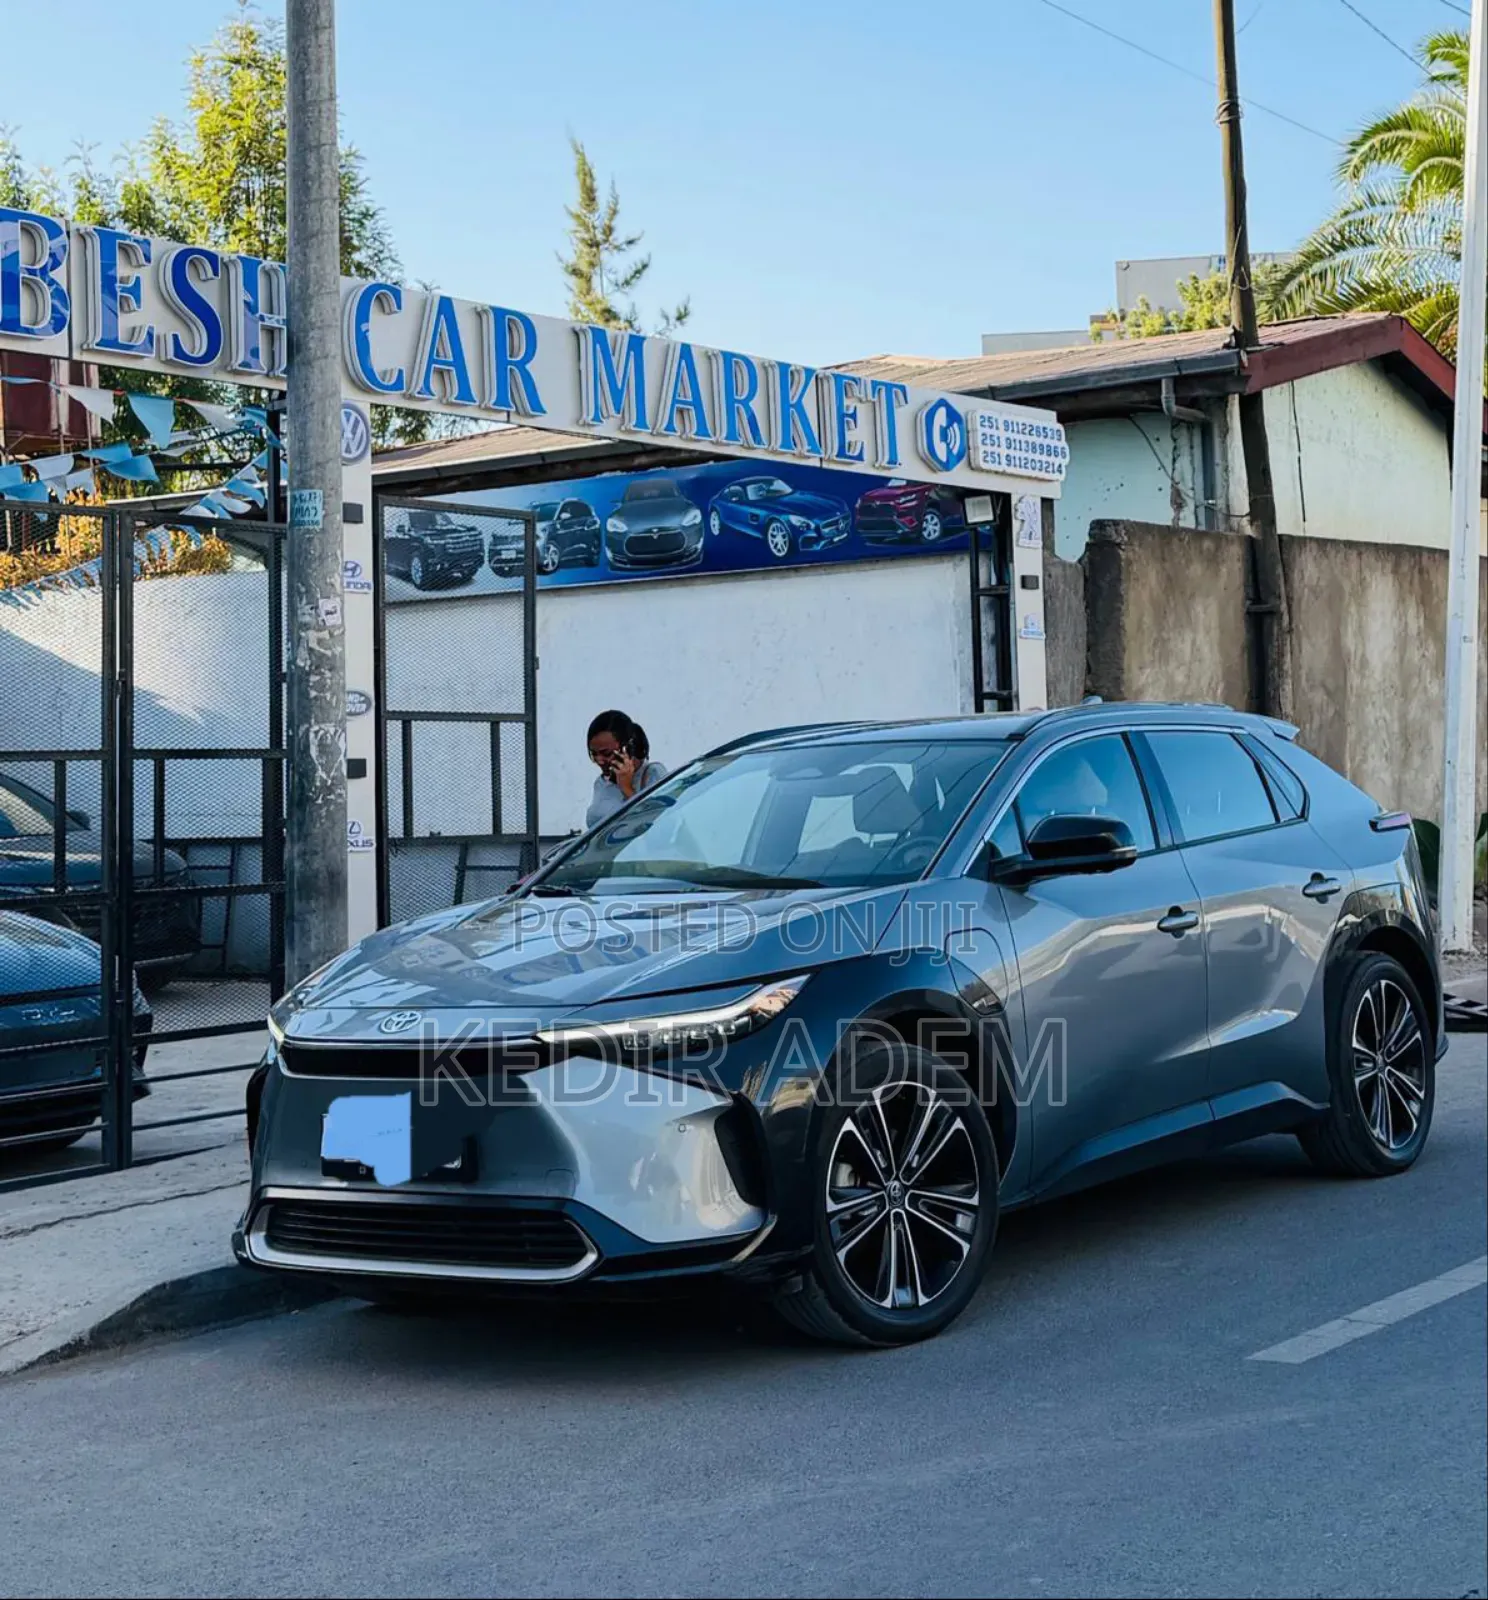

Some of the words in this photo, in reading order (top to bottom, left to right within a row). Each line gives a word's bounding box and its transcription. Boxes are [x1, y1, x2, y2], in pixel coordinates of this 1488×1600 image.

[344, 282, 547, 417] CAR
[576, 324, 909, 470] MARKET
[980, 414, 1000, 431] 251
[1003, 420, 1062, 441] 911226539
[981, 433, 1001, 448] 251
[982, 450, 1002, 466] 251
[1005, 454, 1063, 474] 911203214
